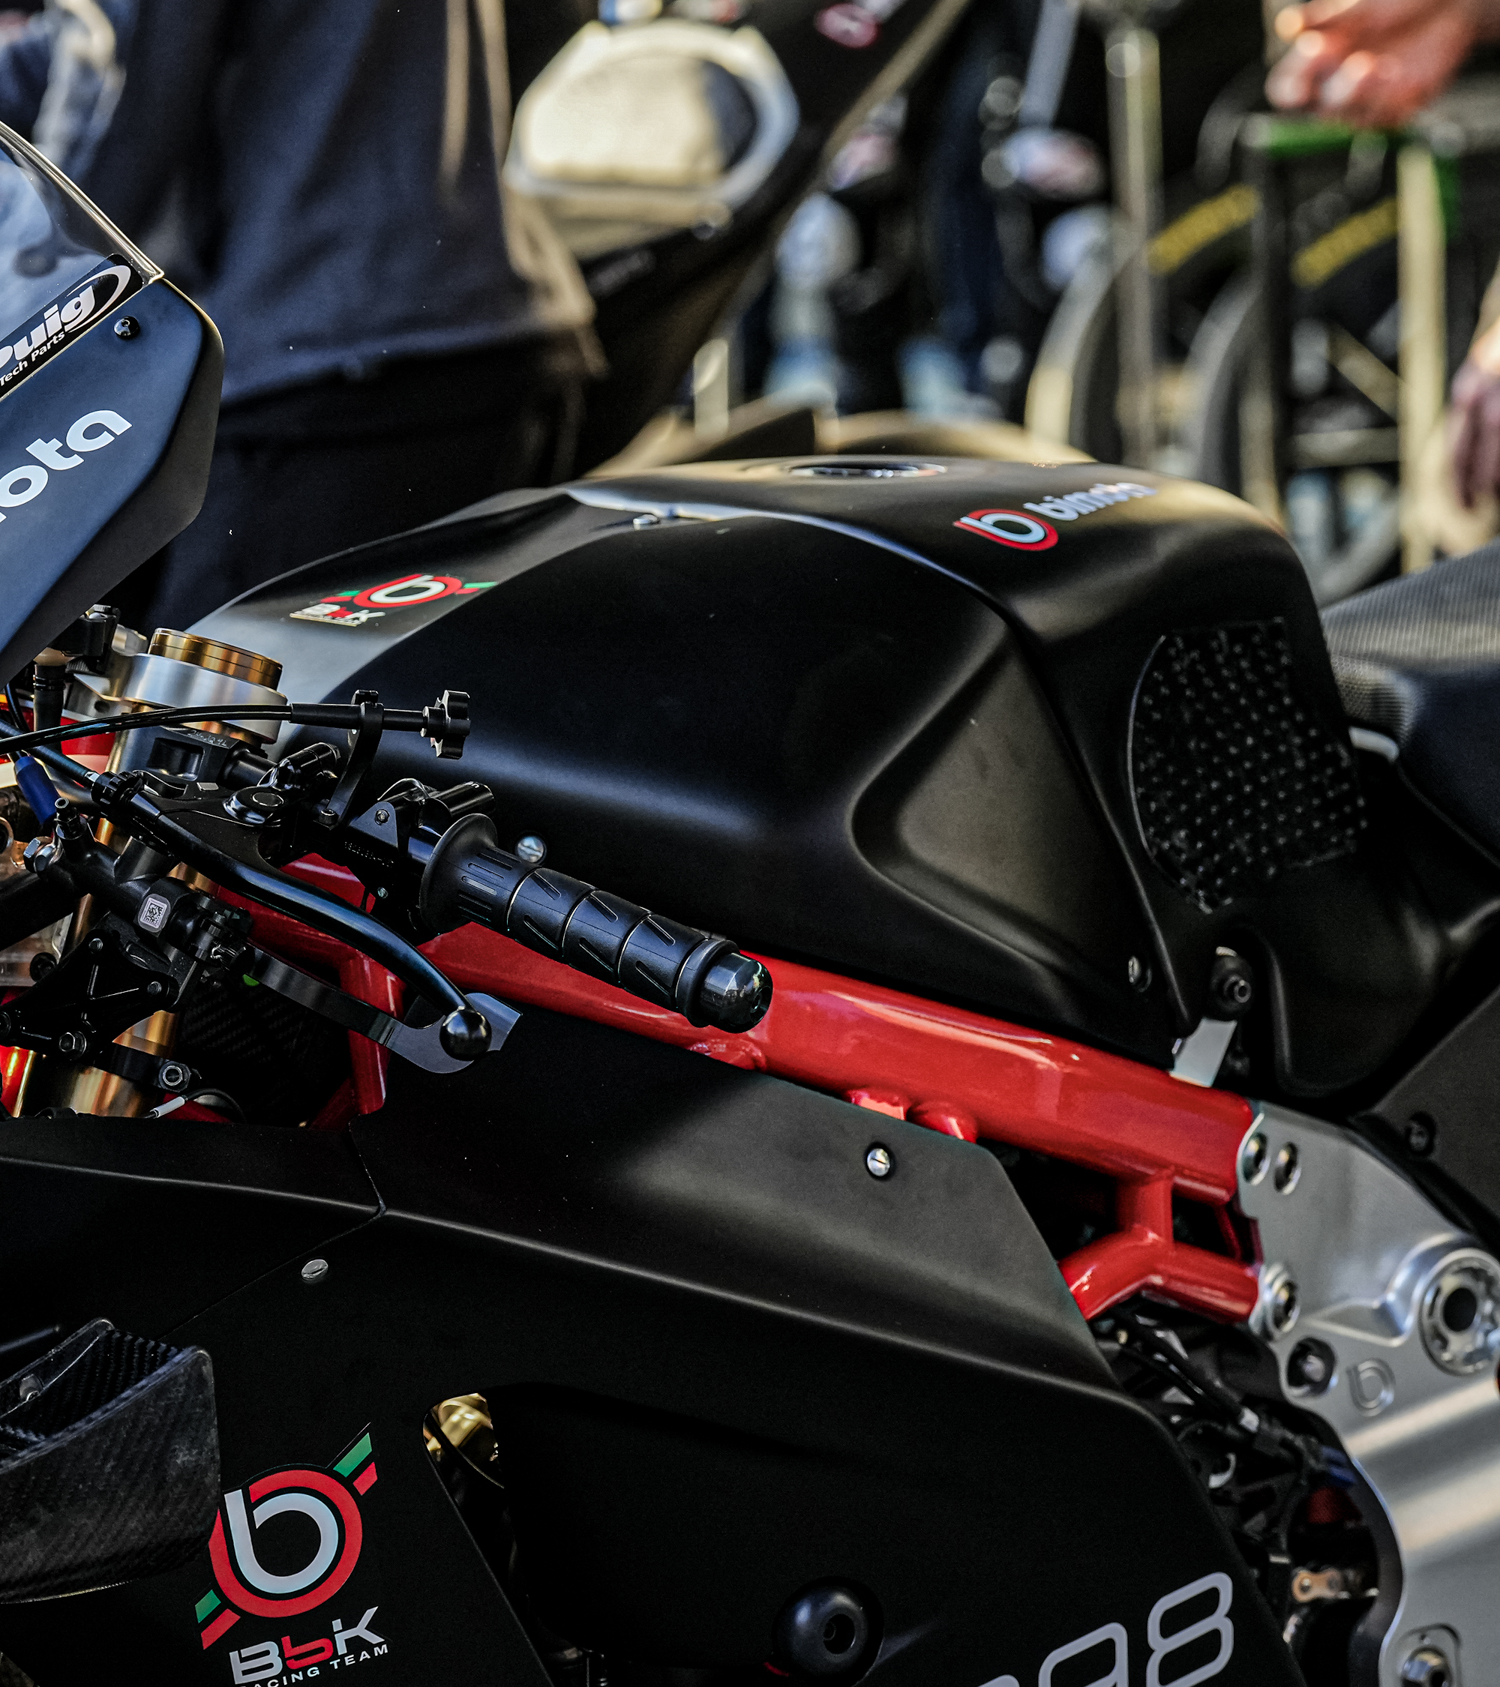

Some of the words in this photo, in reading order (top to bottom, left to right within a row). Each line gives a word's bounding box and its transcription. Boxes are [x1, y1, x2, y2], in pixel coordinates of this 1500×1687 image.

[31, 331, 65, 362] Parts
[241, 1667, 320, 1687] CING
[330, 1644, 388, 1670] TEAM
